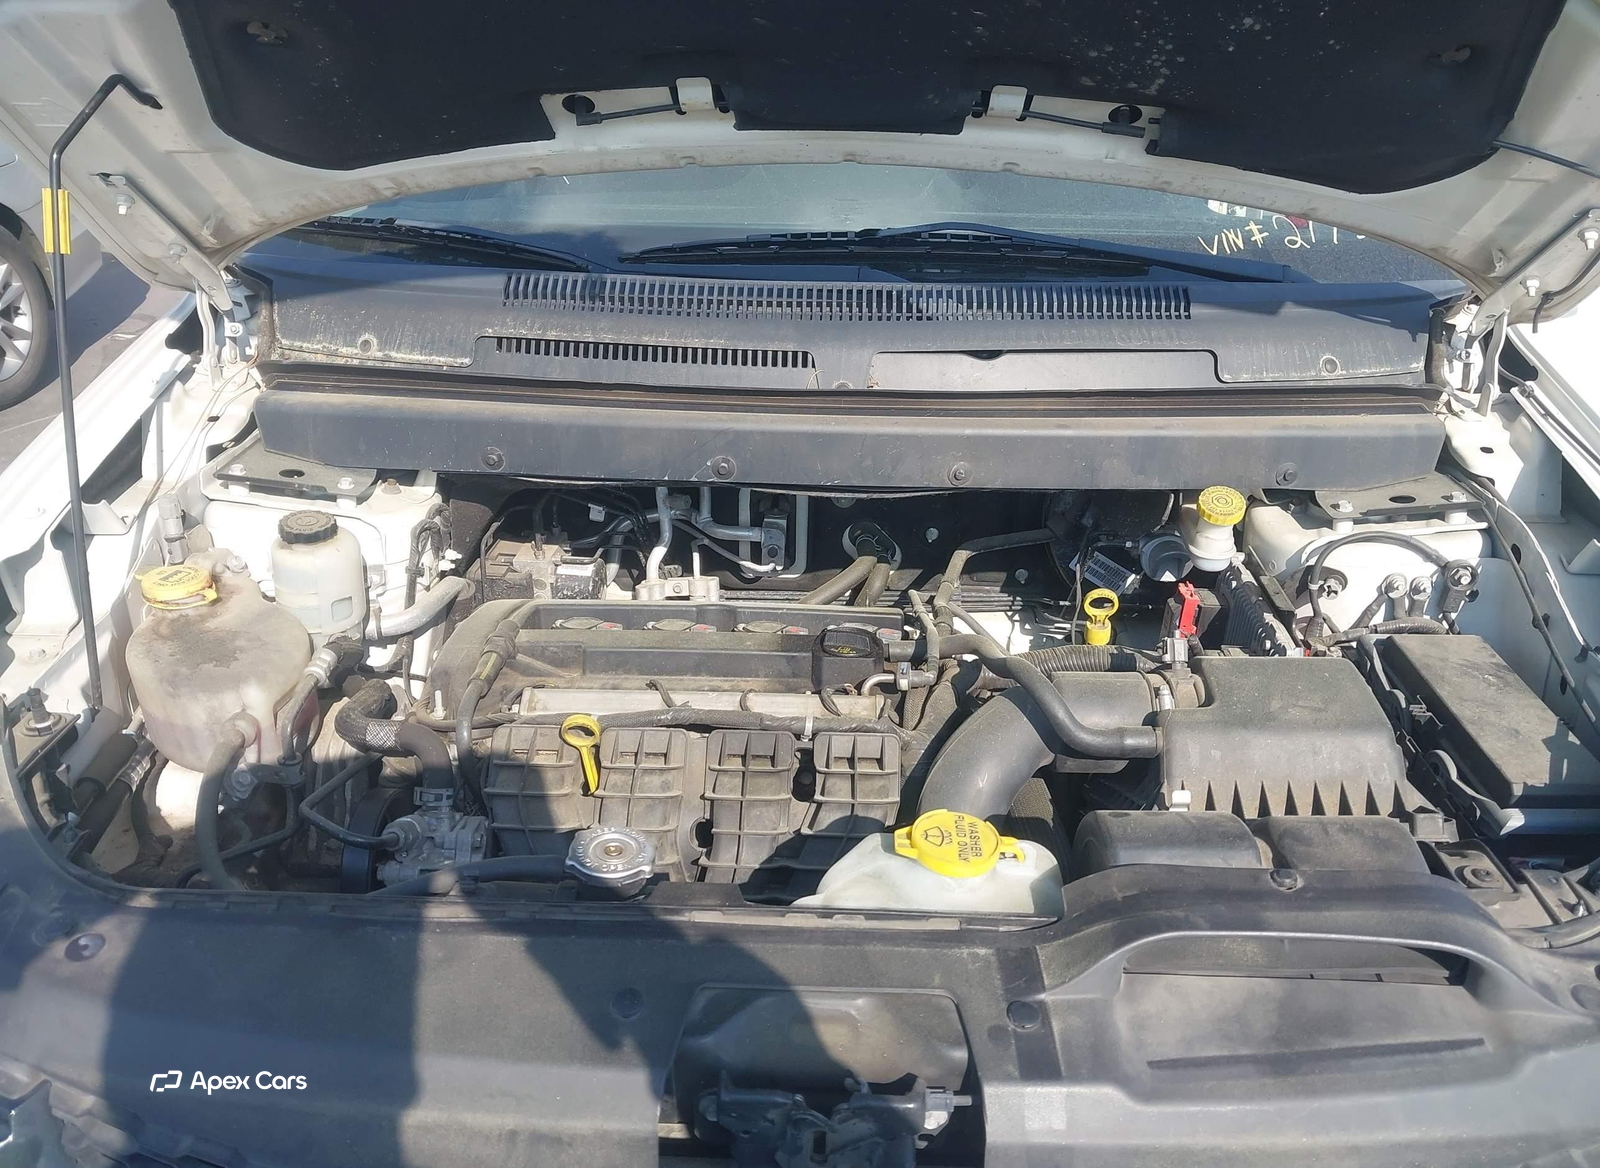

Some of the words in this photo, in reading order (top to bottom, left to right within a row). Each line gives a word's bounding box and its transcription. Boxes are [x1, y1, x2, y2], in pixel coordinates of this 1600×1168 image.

[954, 814, 967, 838] FLUID
[957, 840, 970, 863] ONLY
[968, 821, 982, 858] WASHER
